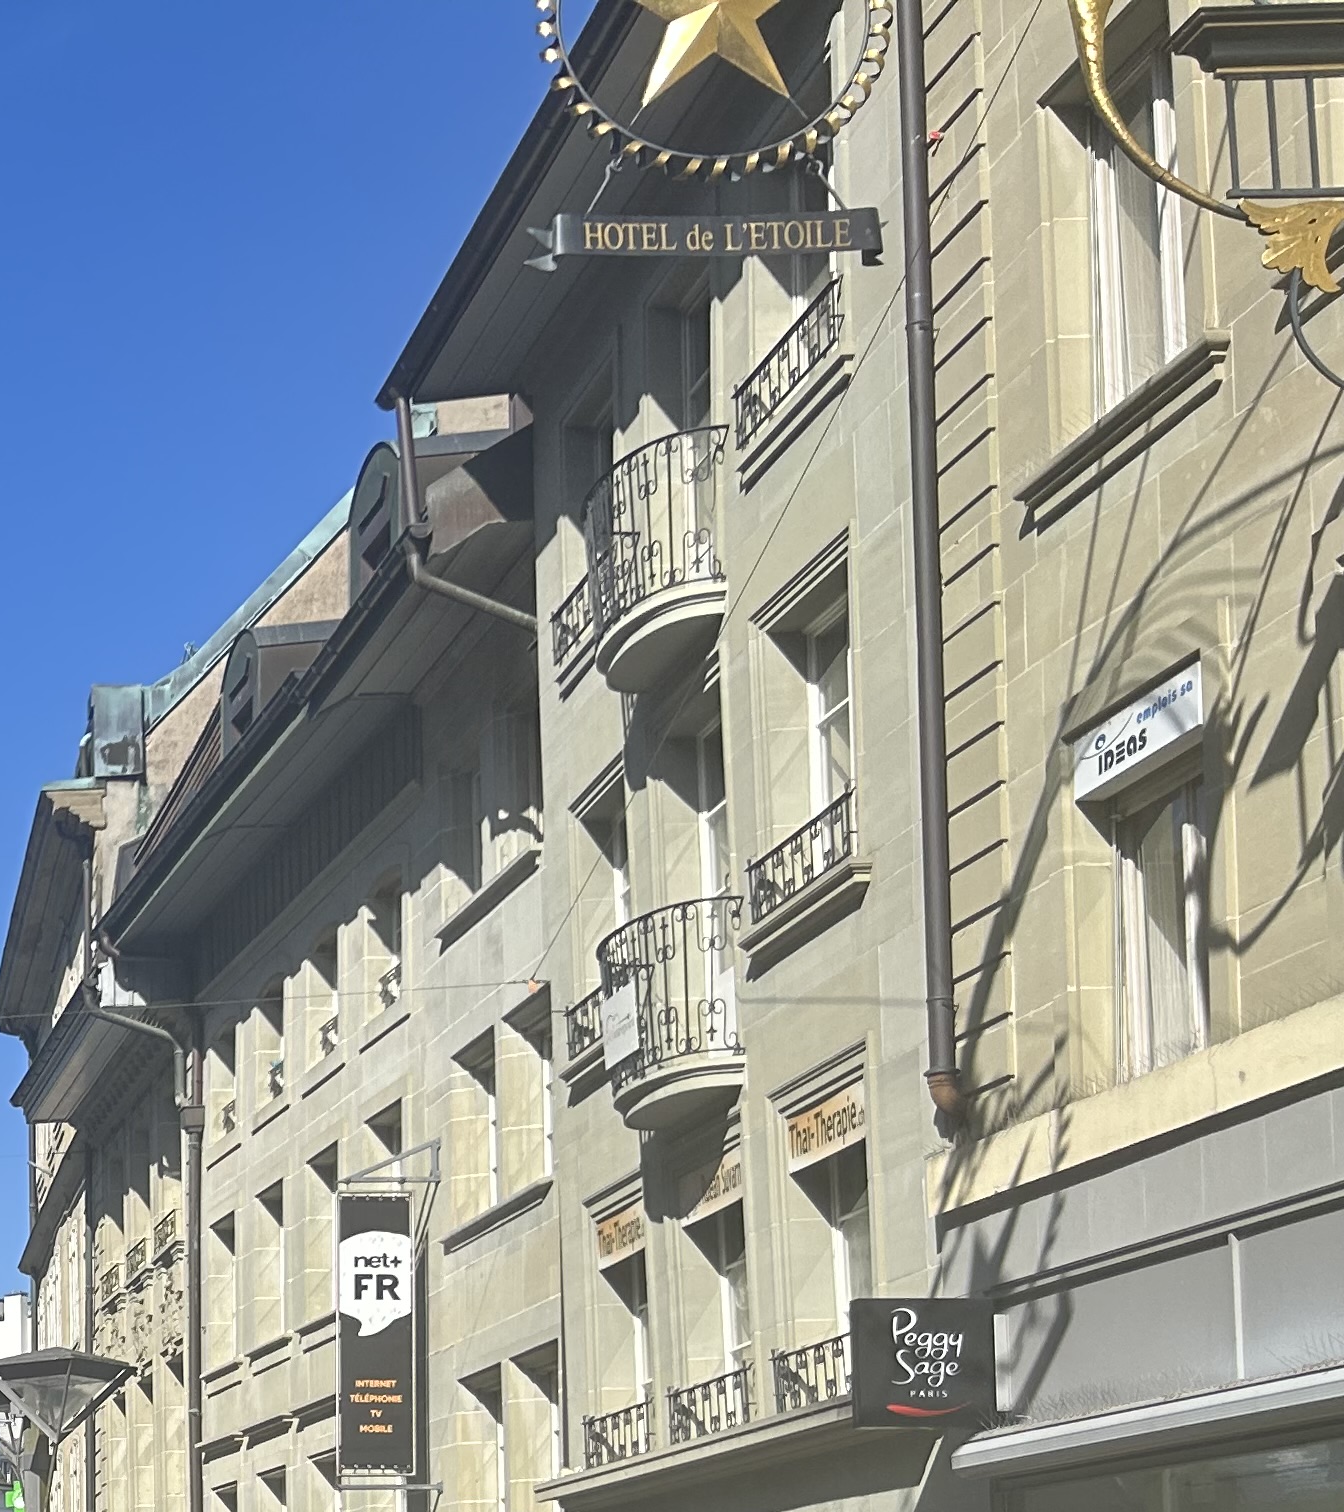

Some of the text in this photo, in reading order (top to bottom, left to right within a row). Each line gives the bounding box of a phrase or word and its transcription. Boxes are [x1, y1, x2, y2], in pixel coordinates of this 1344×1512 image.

[583, 218, 852, 252] HOTEL de L'ETOILE
[1136, 680, 1193, 724] emplois sa
[354, 1253, 402, 1268] net+
[354, 1274, 401, 1301] FR
[891, 1307, 964, 1360] Peggy
[891, 1349, 961, 1387] Sage
[355, 1379, 397, 1388] INTERNET
[349, 1392, 403, 1403] TÉLÉPHONIE
[910, 1390, 948, 1398] PARIS
[370, 1409, 383, 1418] TV
[359, 1424, 393, 1433] MOBILE
